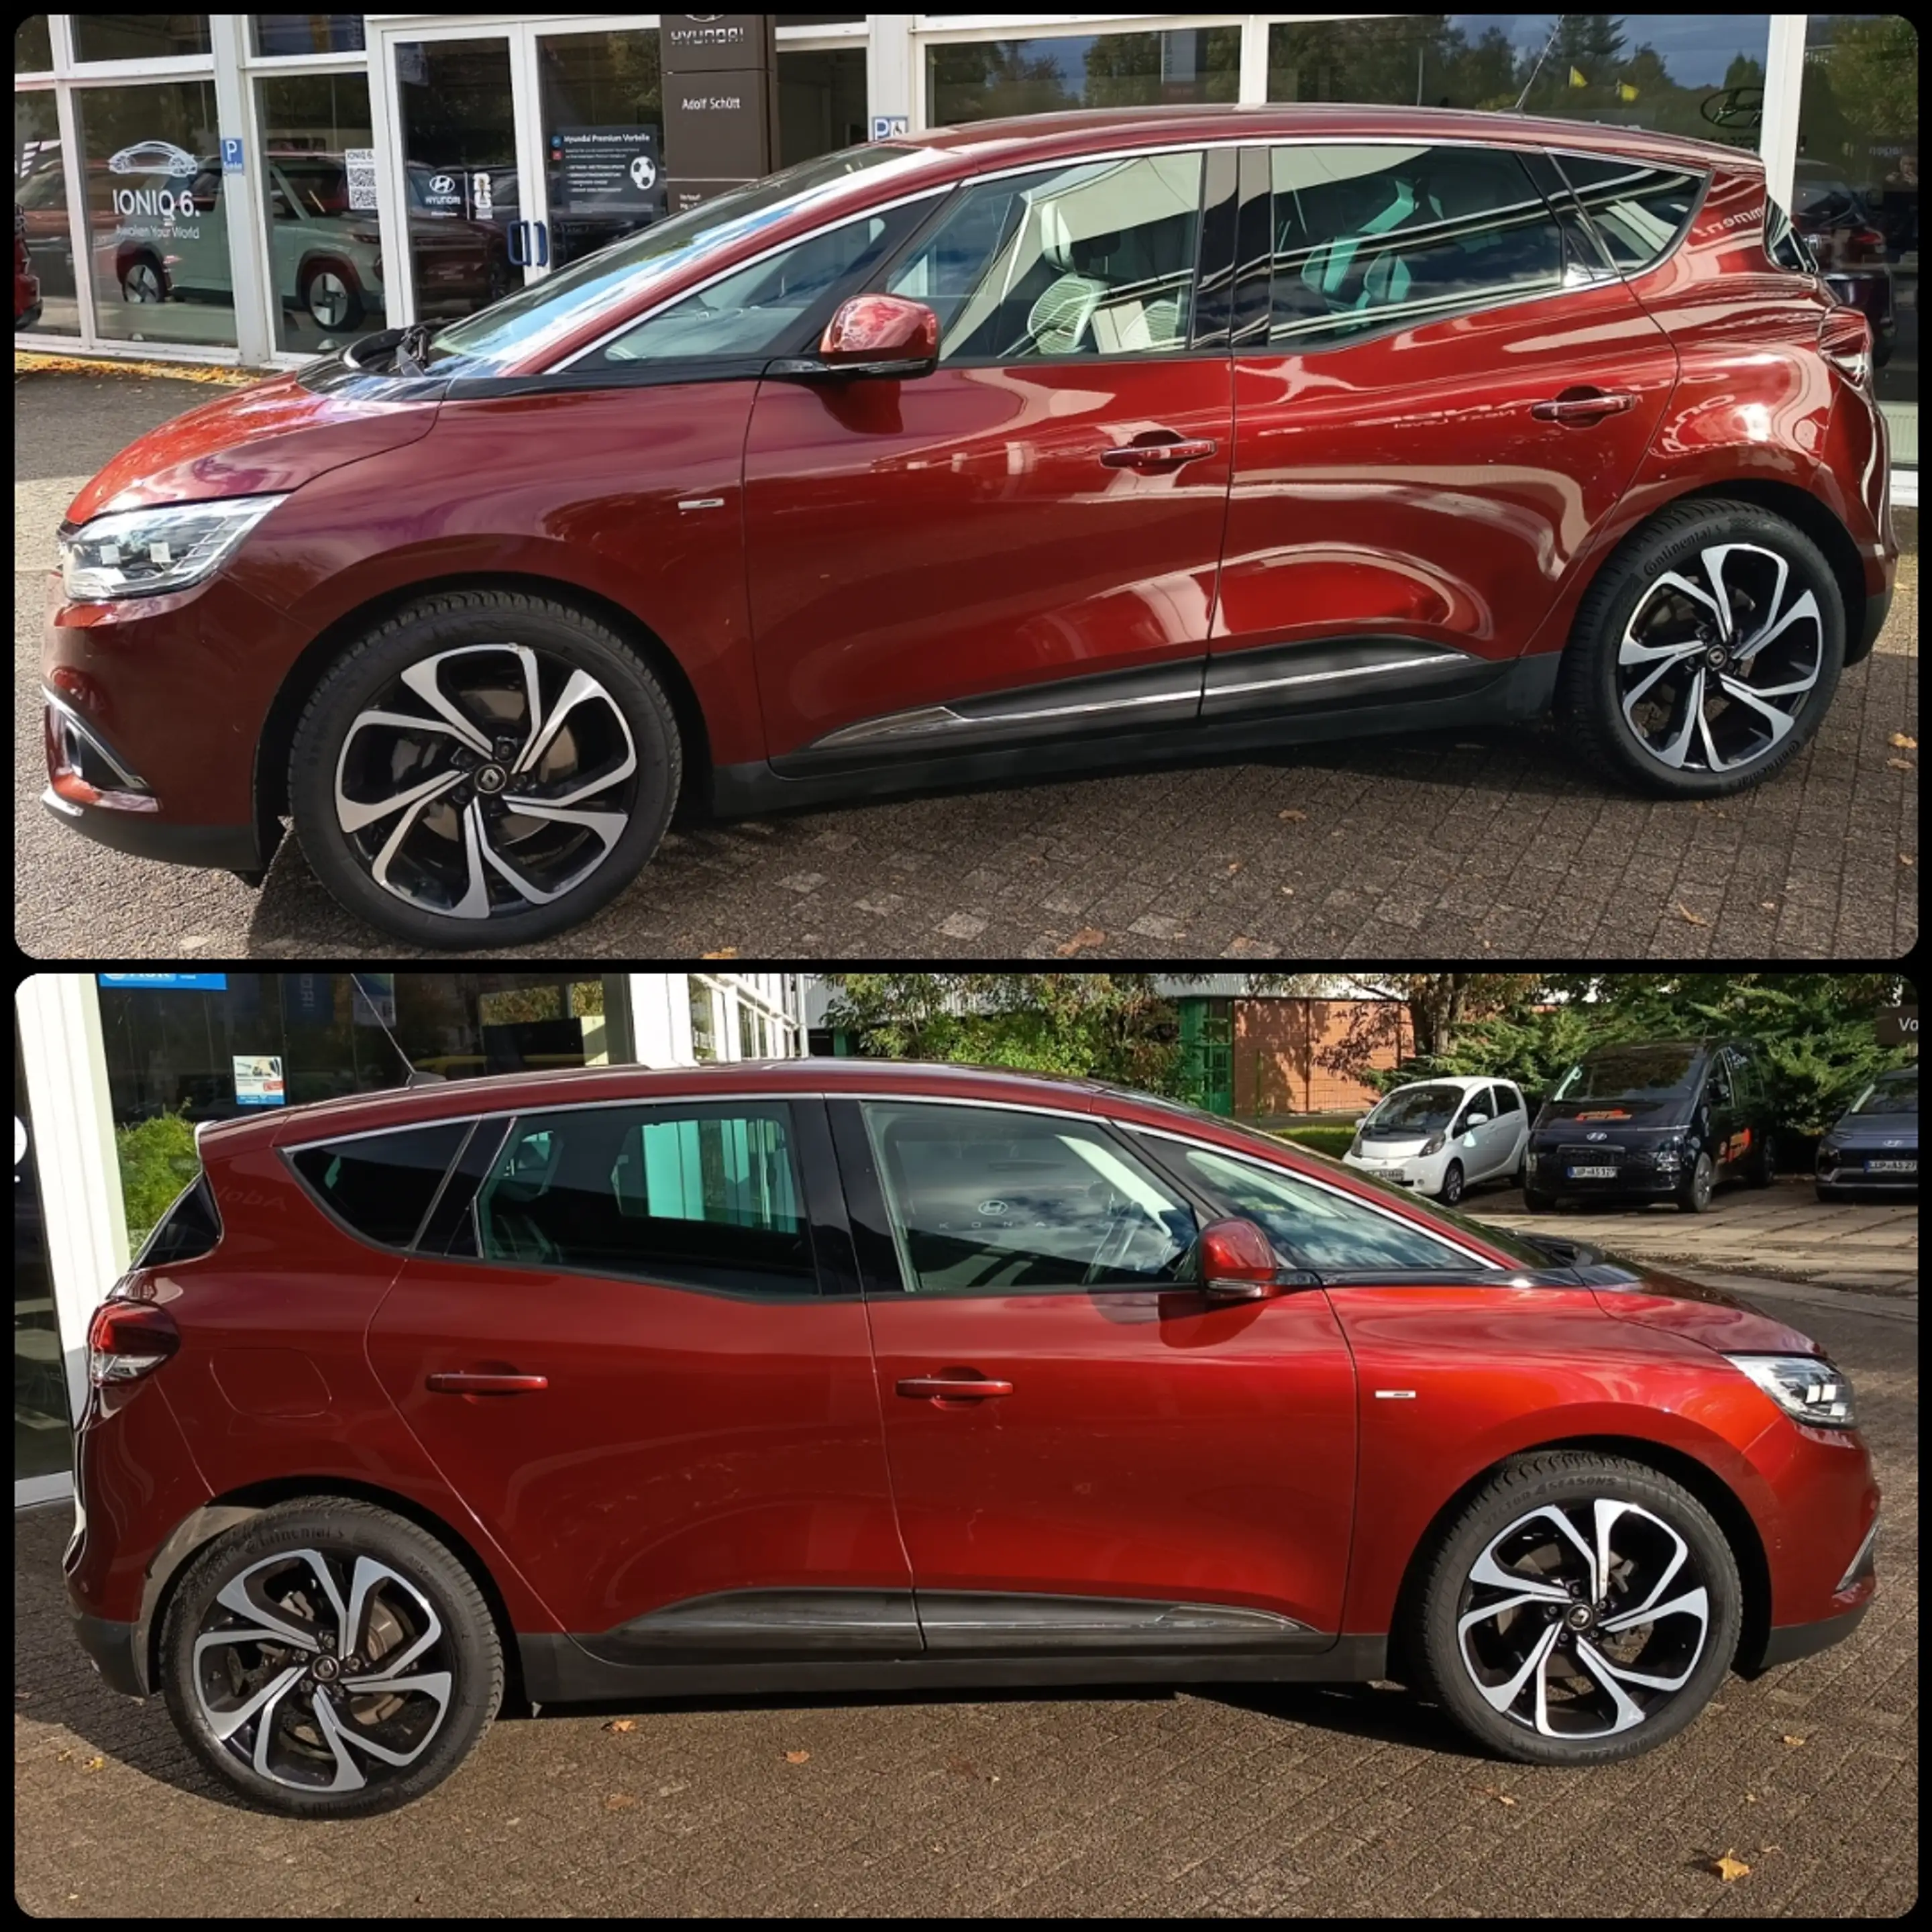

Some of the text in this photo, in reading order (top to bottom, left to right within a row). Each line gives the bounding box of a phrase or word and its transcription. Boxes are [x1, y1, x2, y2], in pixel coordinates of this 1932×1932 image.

[682, 97, 707, 110] Adolf
[875, 119, 888, 140] P
[564, 136, 590, 144] Hyundai
[225, 140, 237, 161] P
[113, 189, 200, 221] IONIQ 6.
[425, 196, 461, 205] HYUNDAI
